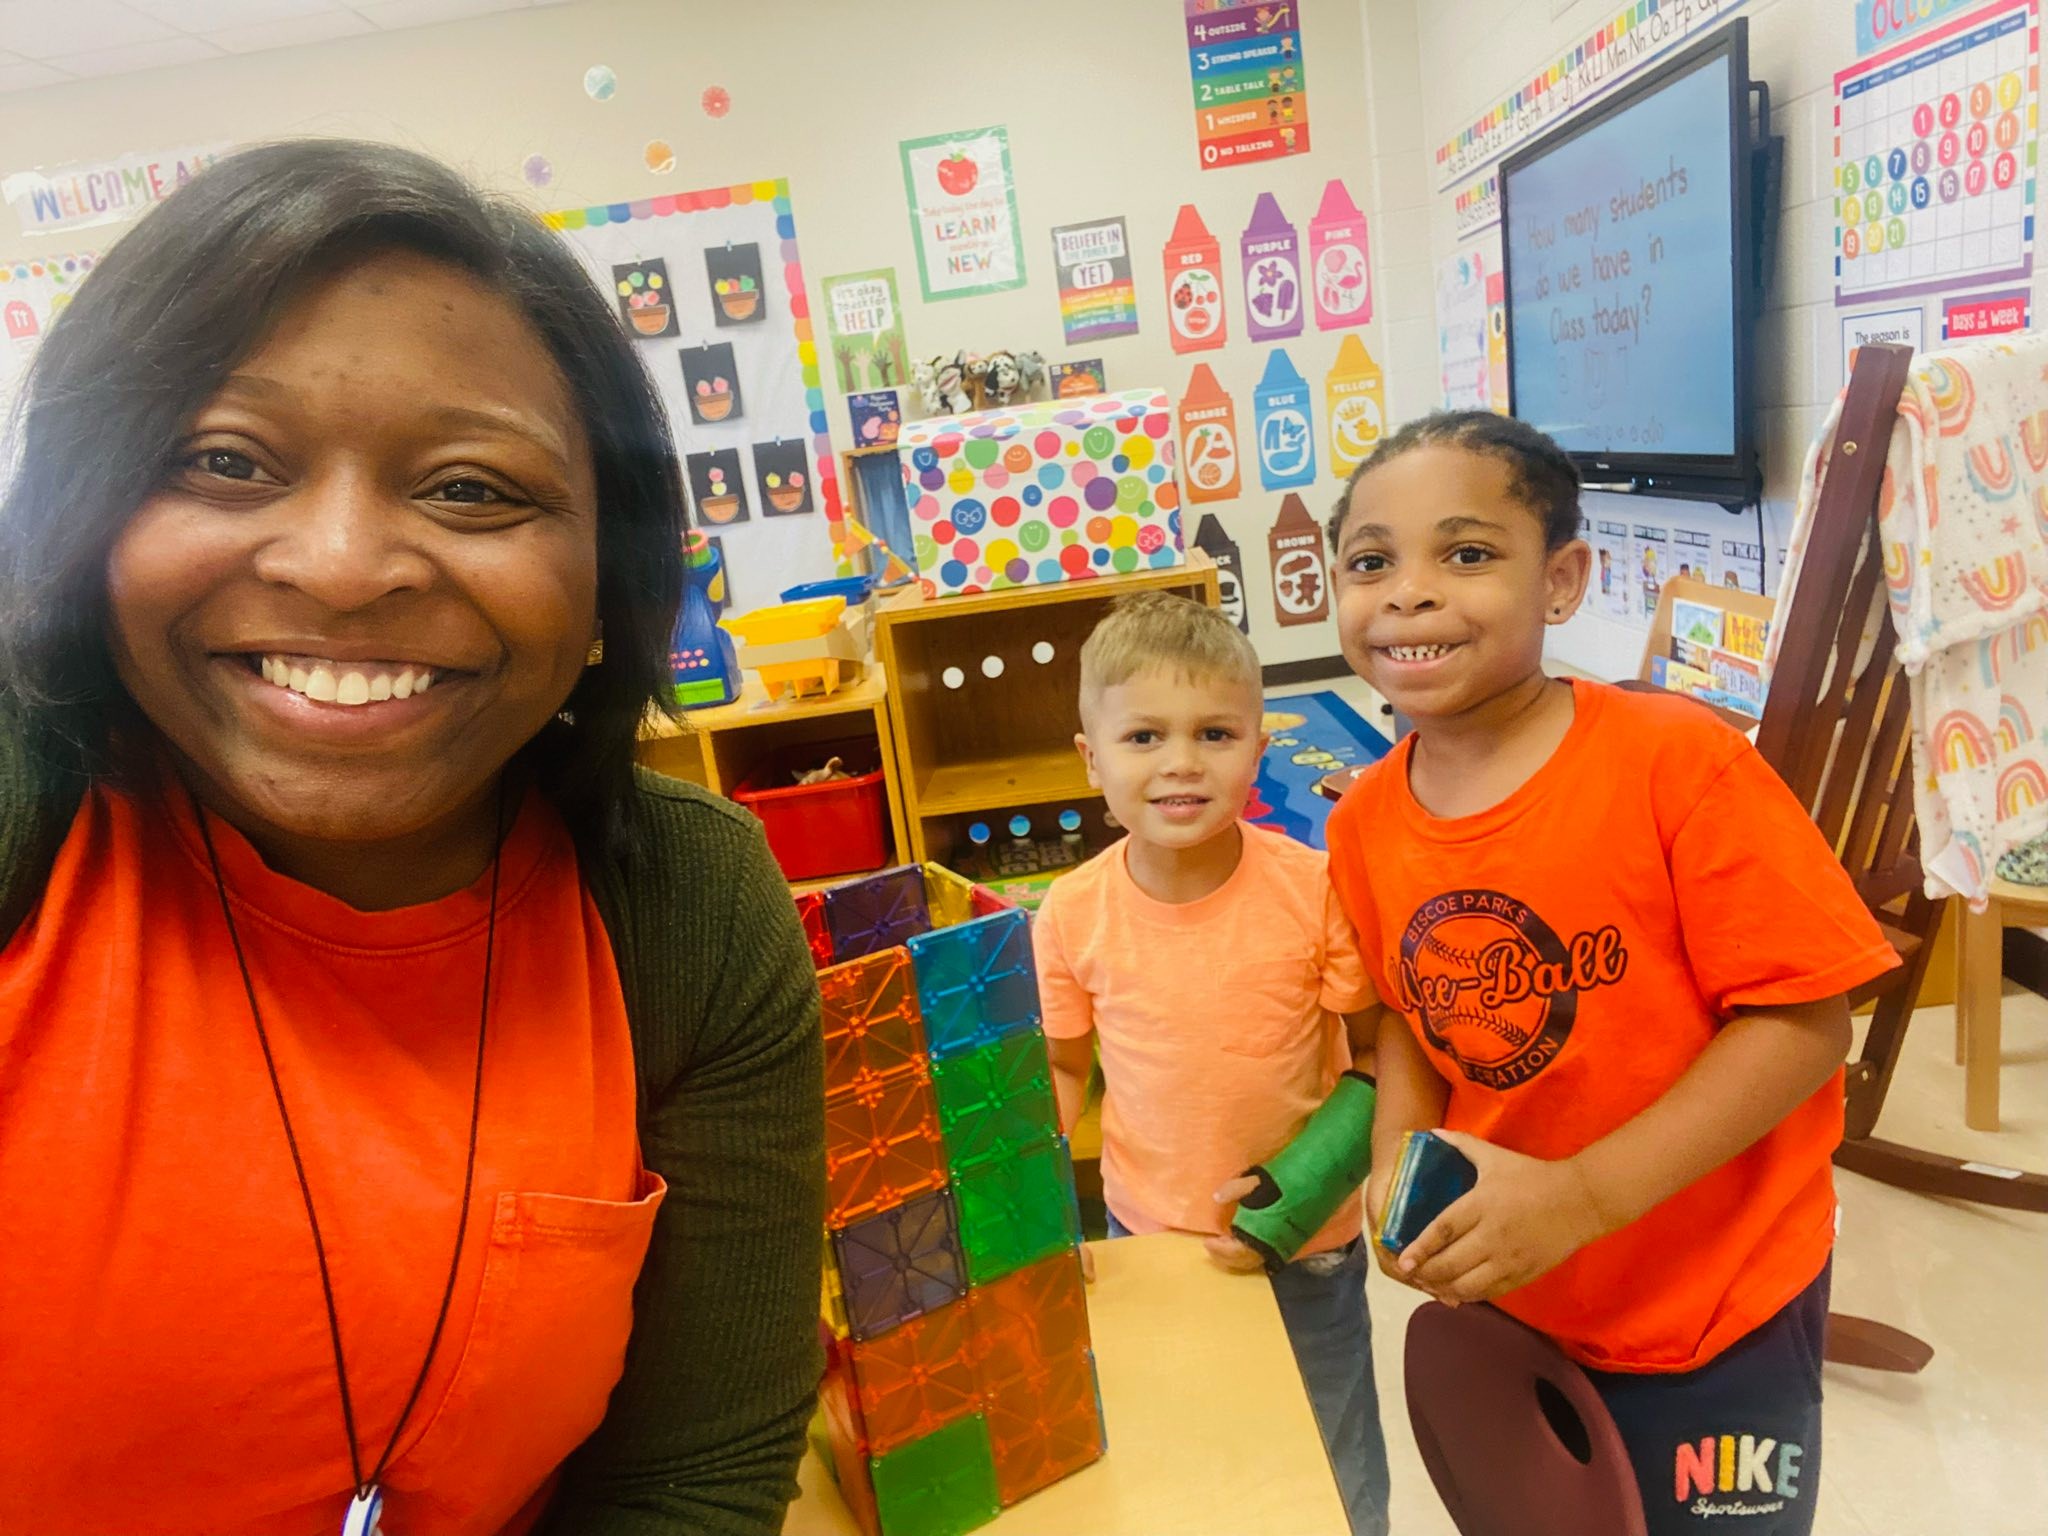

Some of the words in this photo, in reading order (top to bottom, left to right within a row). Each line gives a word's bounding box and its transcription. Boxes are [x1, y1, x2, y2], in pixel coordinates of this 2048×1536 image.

[1194, 24, 1207, 42] 4
[1208, 22, 1248, 38] OUTSIDE
[1606, 41, 1628, 72] Mm
[1629, 26, 1646, 54] Nn
[1650, 12, 1670, 43] Oo
[1196, 52, 1211, 71] 3
[1200, 84, 1214, 102] 2
[1214, 84, 1241, 96] TABLE
[1242, 79, 1265, 92] TALK
[1205, 113, 1215, 131] 1
[1944, 101, 1953, 123] 2
[1219, 146, 1234, 157] NO
[1235, 139, 1275, 155] TALKING
[1893, 153, 1901, 174] 7
[1916, 147, 1924, 168] 8
[1943, 138, 1953, 159] 9
[1970, 128, 1983, 151] 10
[2000, 119, 2012, 143] 11
[30, 162, 166, 223] WELCOME
[1914, 182, 1926, 202] 15
[1942, 174, 1955, 197] 16
[1969, 166, 1981, 189] 17
[1998, 159, 2011, 181] 18
[1563, 202, 1601, 242] many
[1609, 154, 1690, 224] students
[934, 214, 997, 242] LEARN
[1107, 227, 1121, 243] IN
[1181, 252, 1204, 265] RED
[1247, 239, 1292, 256] PURPLE
[947, 250, 993, 275] NEW
[1558, 263, 1582, 293] we
[1591, 245, 1632, 283] have
[1648, 231, 1664, 265] in
[1078, 262, 1106, 287] YET
[844, 308, 885, 332] HELP
[1332, 379, 1377, 394] YELLOW
[1267, 393, 1296, 408] BLUE
[1276, 534, 1316, 550] BROWN
[1407, 896, 1458, 943] BISCOE
[1462, 895, 1528, 926] PARKS
[1674, 1433, 1804, 1503] NIKE
[1689, 1496, 1785, 1520] Sportswear
